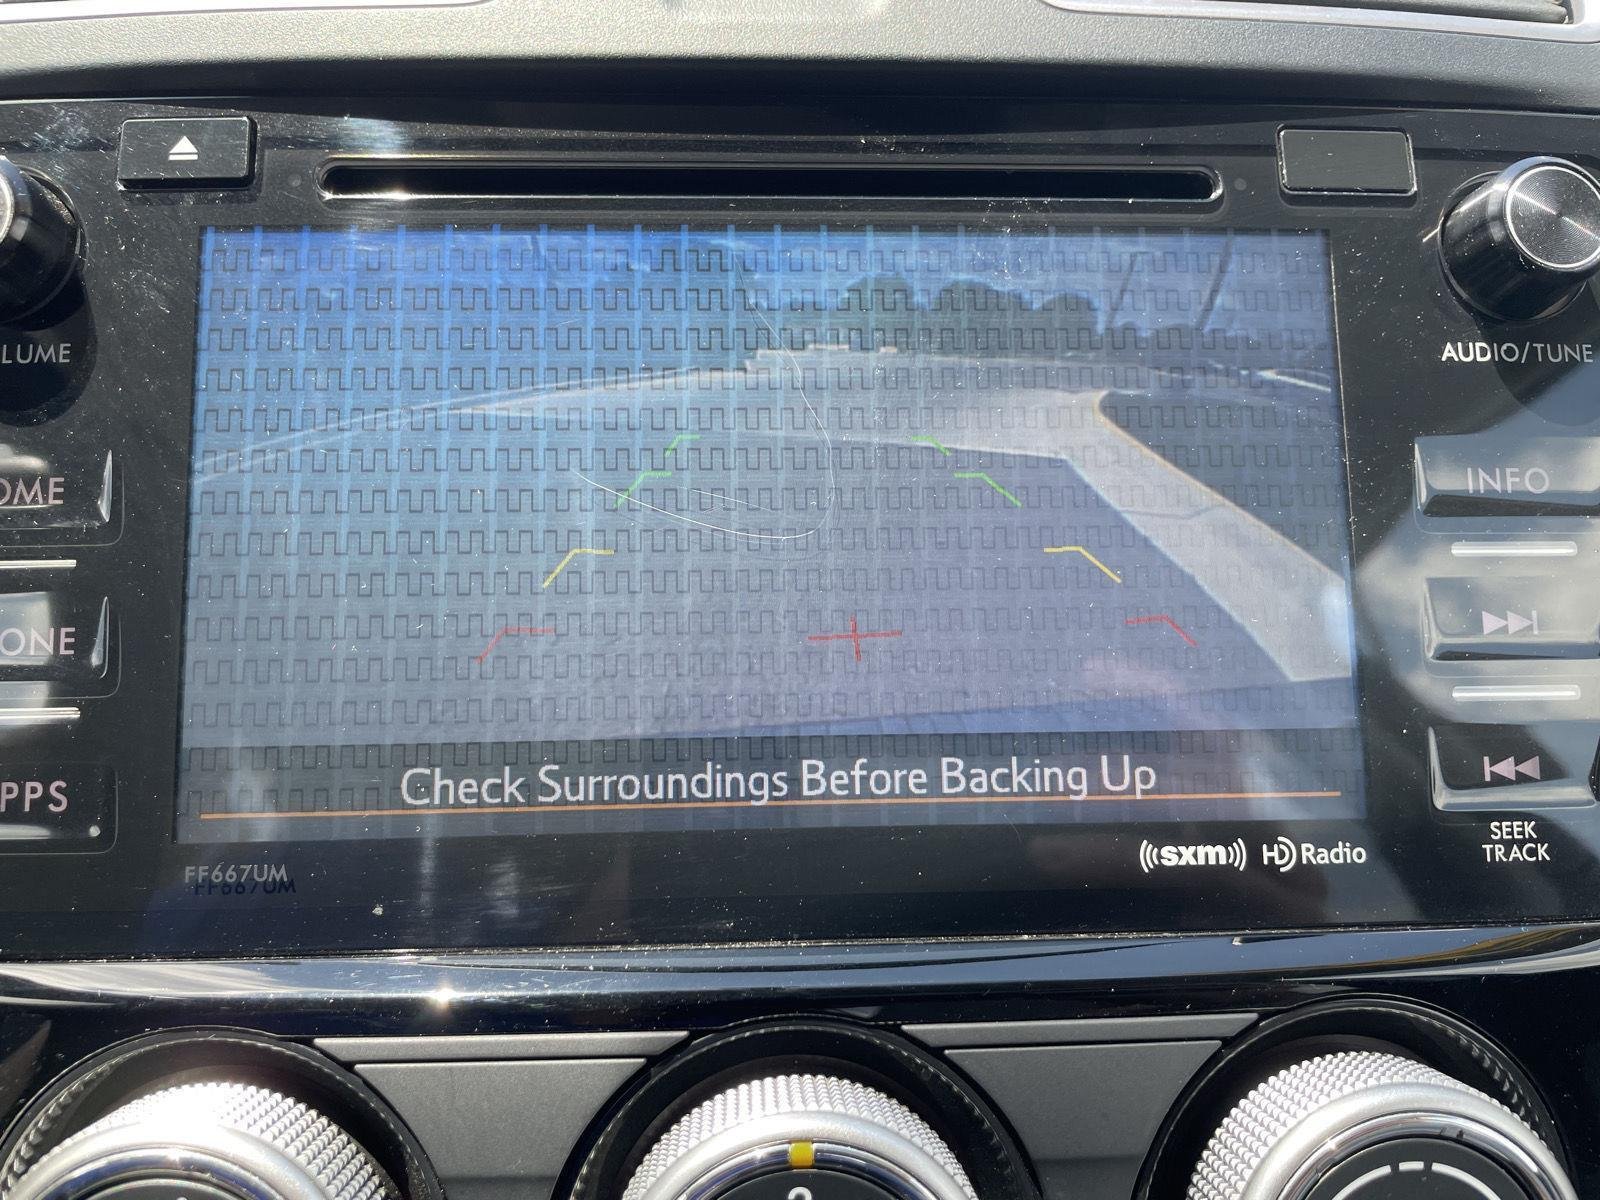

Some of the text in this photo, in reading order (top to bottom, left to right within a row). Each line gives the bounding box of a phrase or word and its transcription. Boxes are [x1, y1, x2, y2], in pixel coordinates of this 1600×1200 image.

[1441, 341, 1594, 363] AUDIO/TUNE
[1466, 467, 1549, 494] INFO
[400, 754, 1156, 806] Check Surroundings Before Backing Up
[1490, 821, 1538, 840] SEEK
[1160, 845, 1227, 866] sxm
[1262, 836, 1367, 872] HD Radio
[1482, 843, 1551, 863] TRACK
[184, 863, 288, 883] FF667UM
